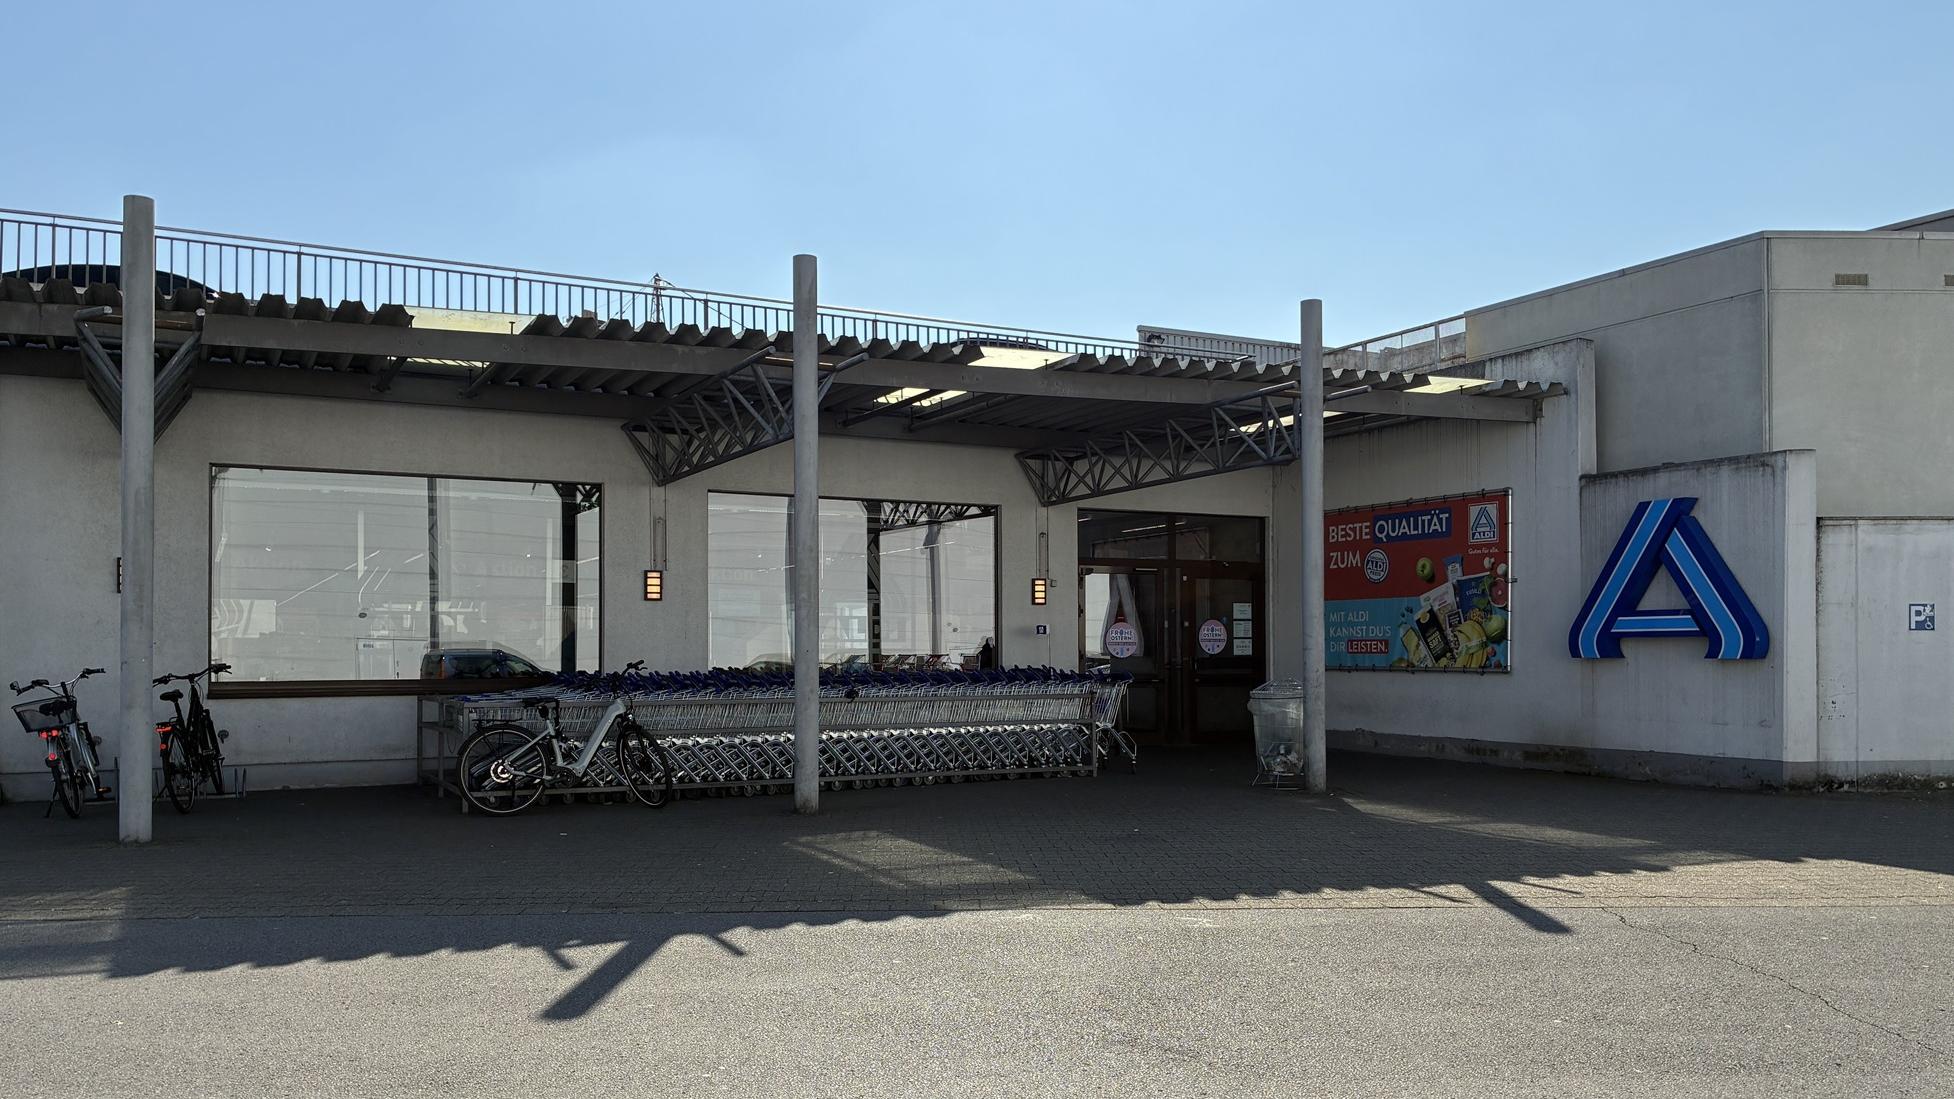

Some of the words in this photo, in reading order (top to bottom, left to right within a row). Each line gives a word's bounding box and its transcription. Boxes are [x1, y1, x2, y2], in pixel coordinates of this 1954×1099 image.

[1329, 522, 1371, 542] BESTE
[1375, 510, 1449, 542] QUALITÄT
[1473, 531, 1494, 539] ALDI
[1329, 550, 1361, 569] ZUM
[1366, 559, 1386, 572] ALDI
[1330, 611, 1345, 622] MIT
[1347, 610, 1369, 621] ALDI
[1910, 606, 1926, 629] P
[1330, 626, 1367, 637] KANNST
[1369, 625, 1392, 637] DU'S
[1330, 641, 1346, 652] DIR
[1348, 641, 1388, 652] LEISTEN.
